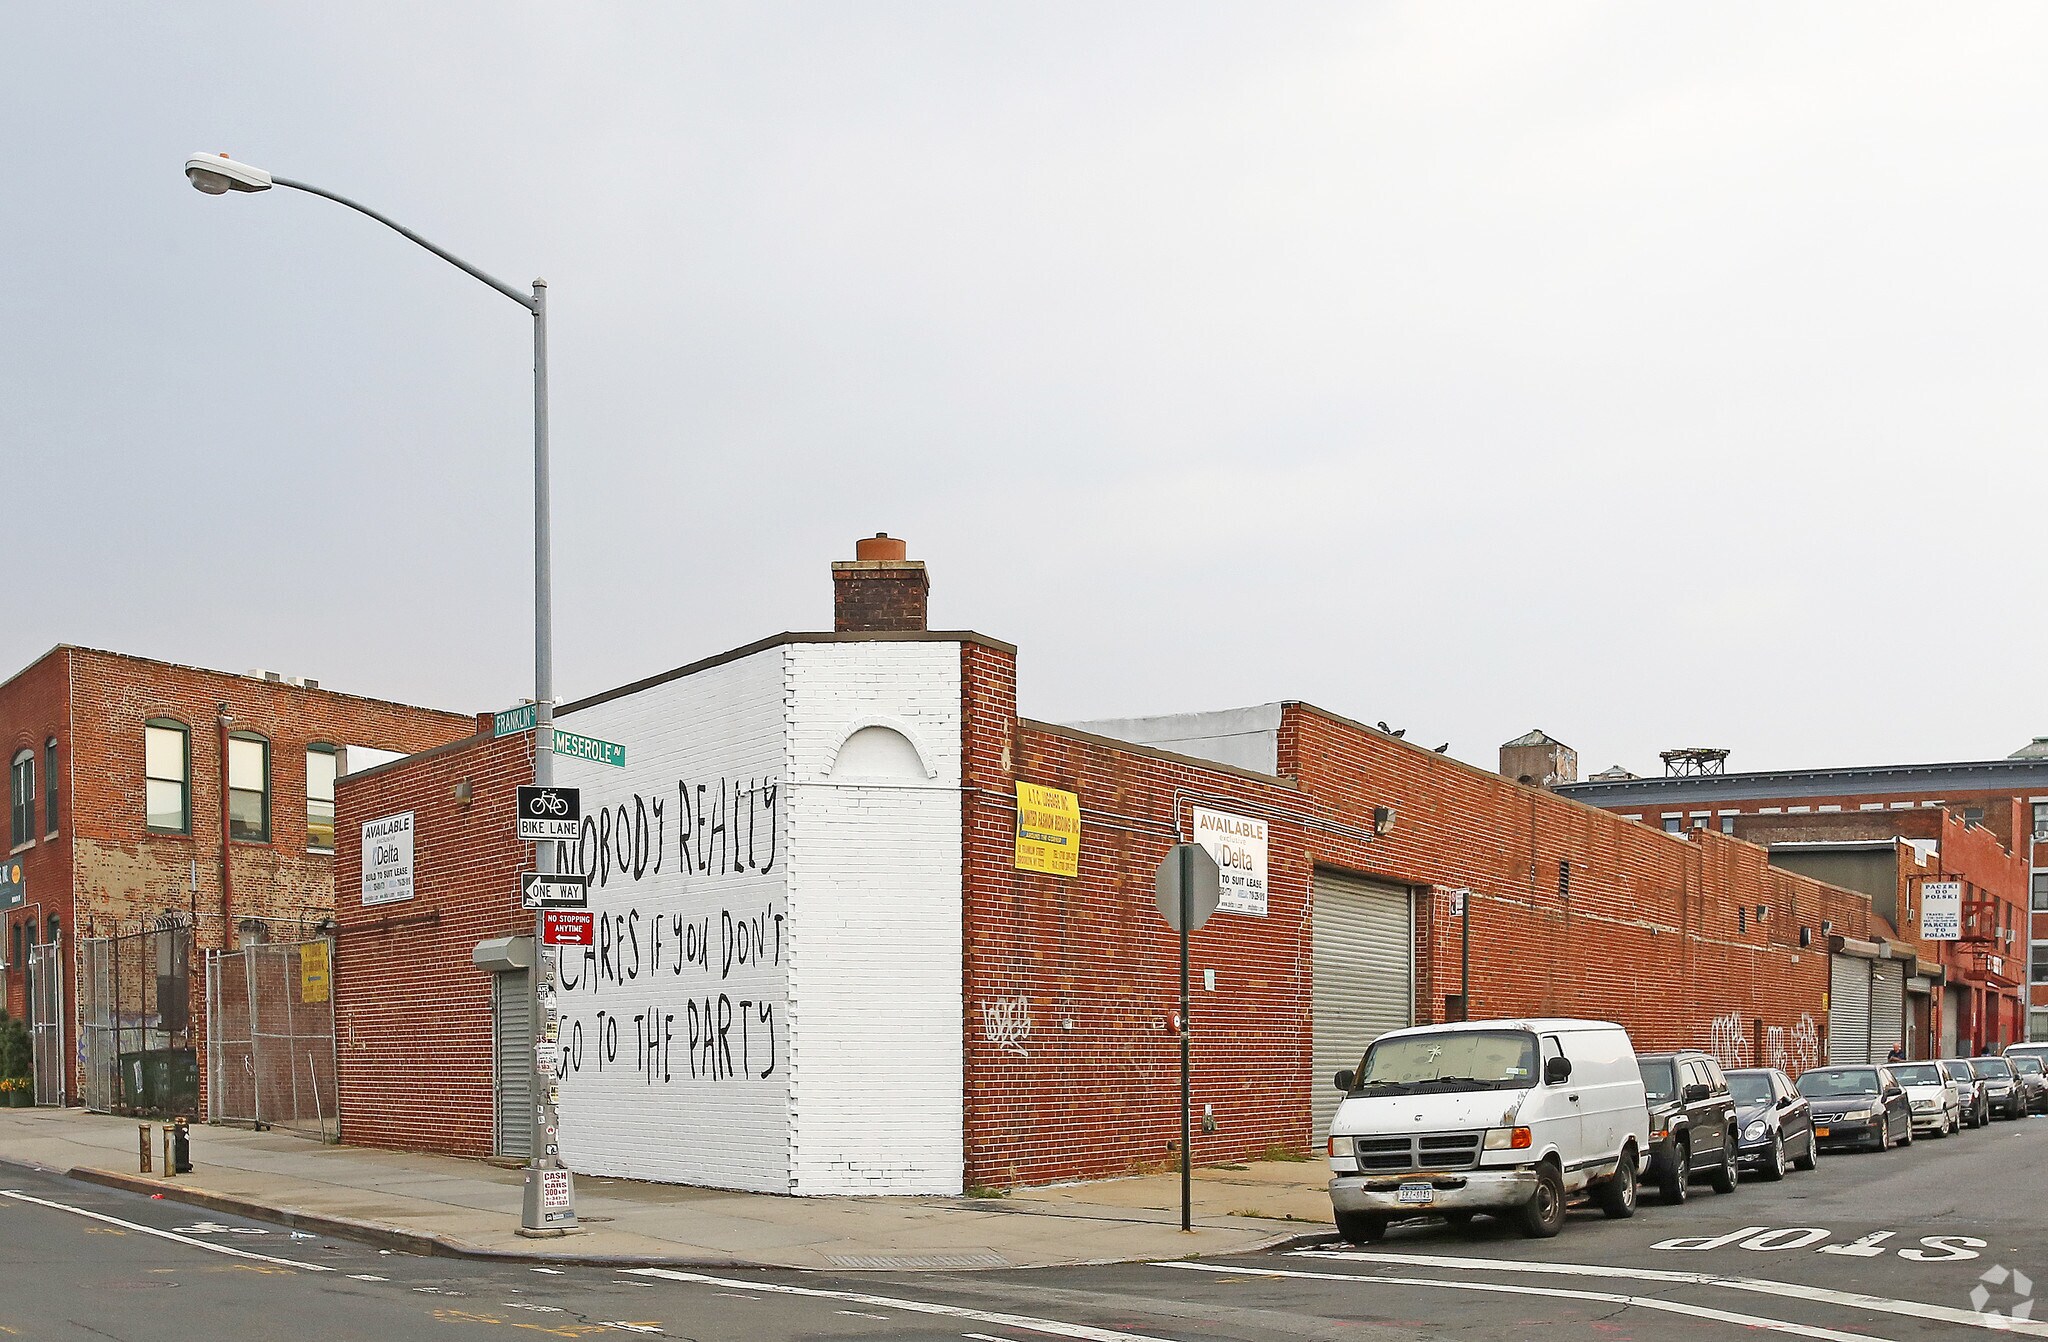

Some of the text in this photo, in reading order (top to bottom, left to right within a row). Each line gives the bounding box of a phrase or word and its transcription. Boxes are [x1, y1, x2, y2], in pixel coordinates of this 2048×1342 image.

[496, 707, 531, 734] FRANKLIN
[556, 732, 612, 763] MESEROLE
[365, 817, 410, 840] AVAILABLE
[521, 821, 577, 835] BIKE LANE
[557, 776, 778, 888] NOBODY REALLY
[1200, 814, 1263, 840] AVAILABLE
[1219, 834, 1246, 846] exclusive
[377, 844, 399, 866] Delta
[1222, 844, 1253, 872] Delta
[365, 866, 408, 882] BUILD TO SUIT LEASE
[1221, 874, 1262, 889] TO SUIT LEASE
[532, 884, 579, 898] ONE WAY
[547, 914, 591, 924] NO STOPPING
[554, 924, 583, 933] ANYTIME
[560, 902, 784, 994] CARES IF YOU DON'T
[556, 993, 776, 1085] GO TO THE PARTY
[544, 1172, 567, 1180] CASH
[1650, 1225, 1988, 1262] STOP
